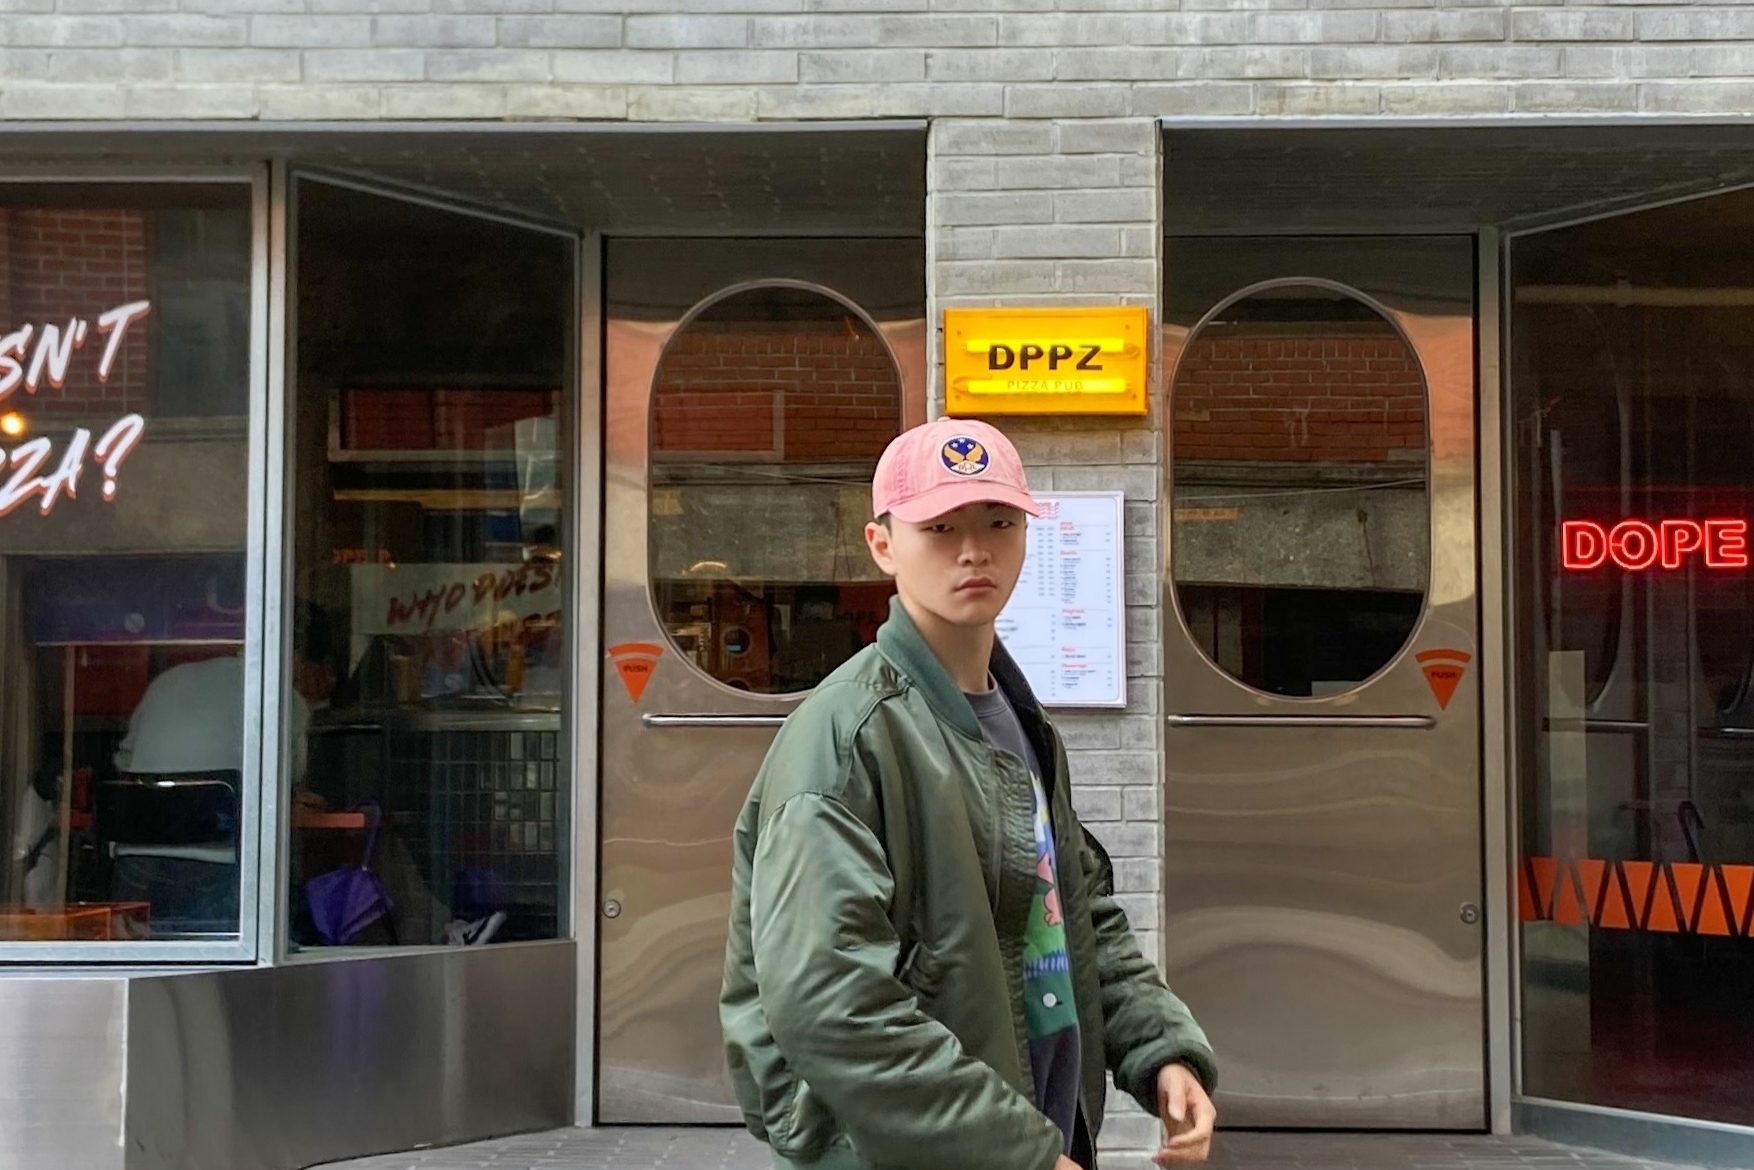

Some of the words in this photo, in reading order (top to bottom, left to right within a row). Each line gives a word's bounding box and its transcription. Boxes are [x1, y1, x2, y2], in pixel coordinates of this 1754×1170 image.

[988, 343, 1104, 371] DPPZ
[1006, 380, 1049, 392] PIZZA
[1054, 380, 1084, 391] PUB
[0, 414, 145, 517] ZA?
[1562, 519, 1748, 570] DOPE
[623, 664, 648, 673] PUSH
